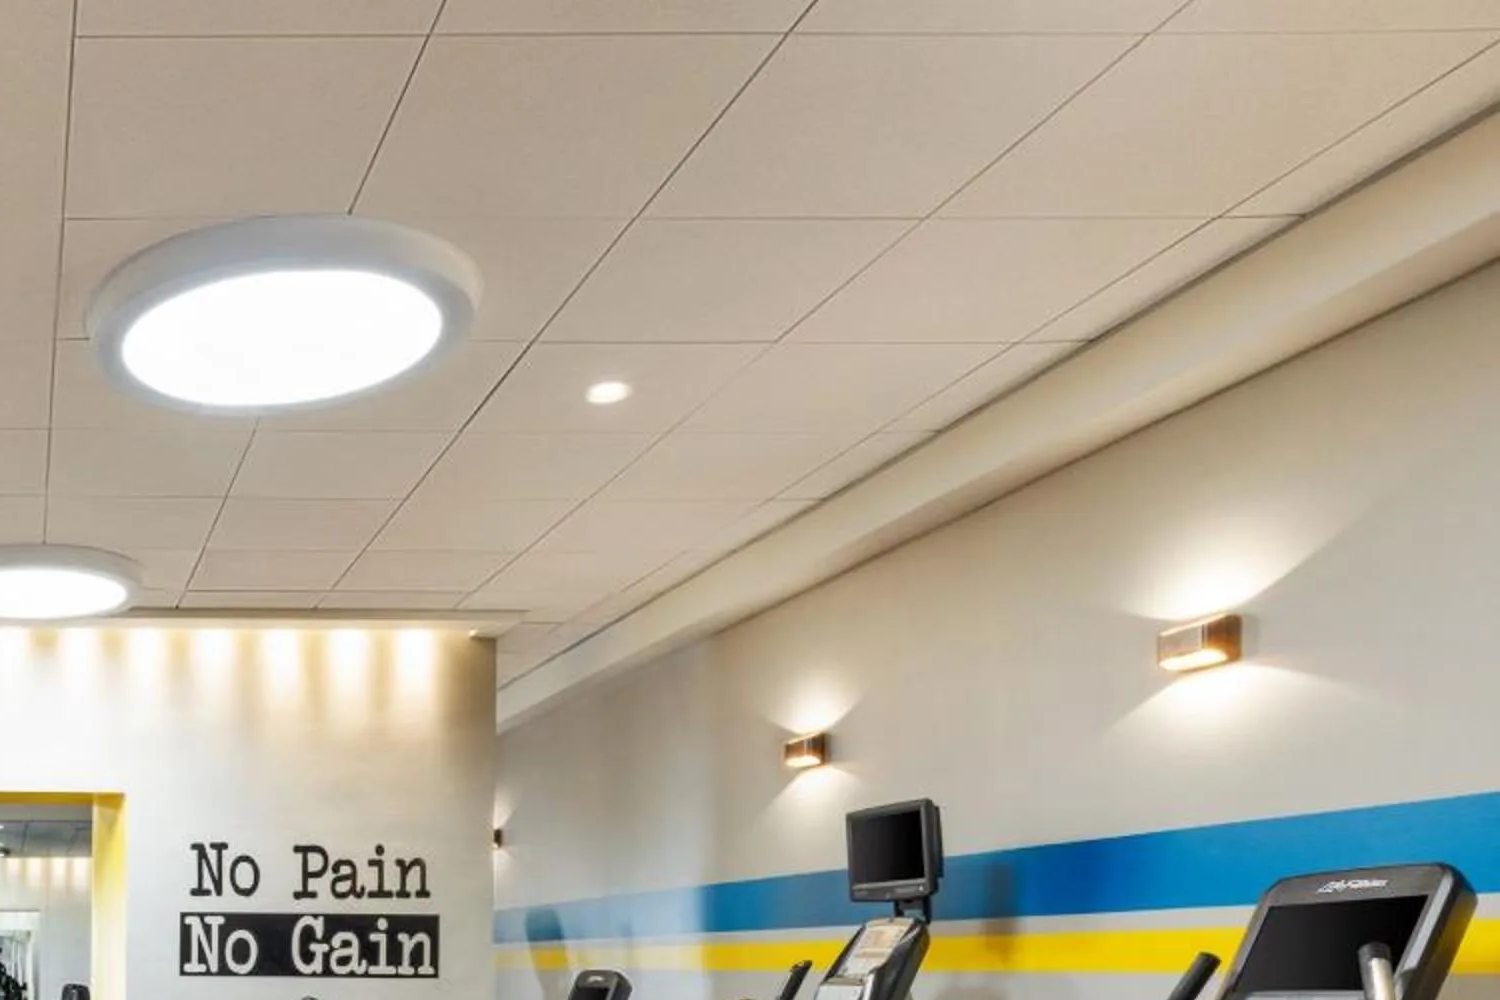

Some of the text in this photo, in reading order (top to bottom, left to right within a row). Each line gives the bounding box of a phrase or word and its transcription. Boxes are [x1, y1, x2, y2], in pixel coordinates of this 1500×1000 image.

[190, 842, 431, 899] No Pain
[183, 915, 435, 975] No Gain
